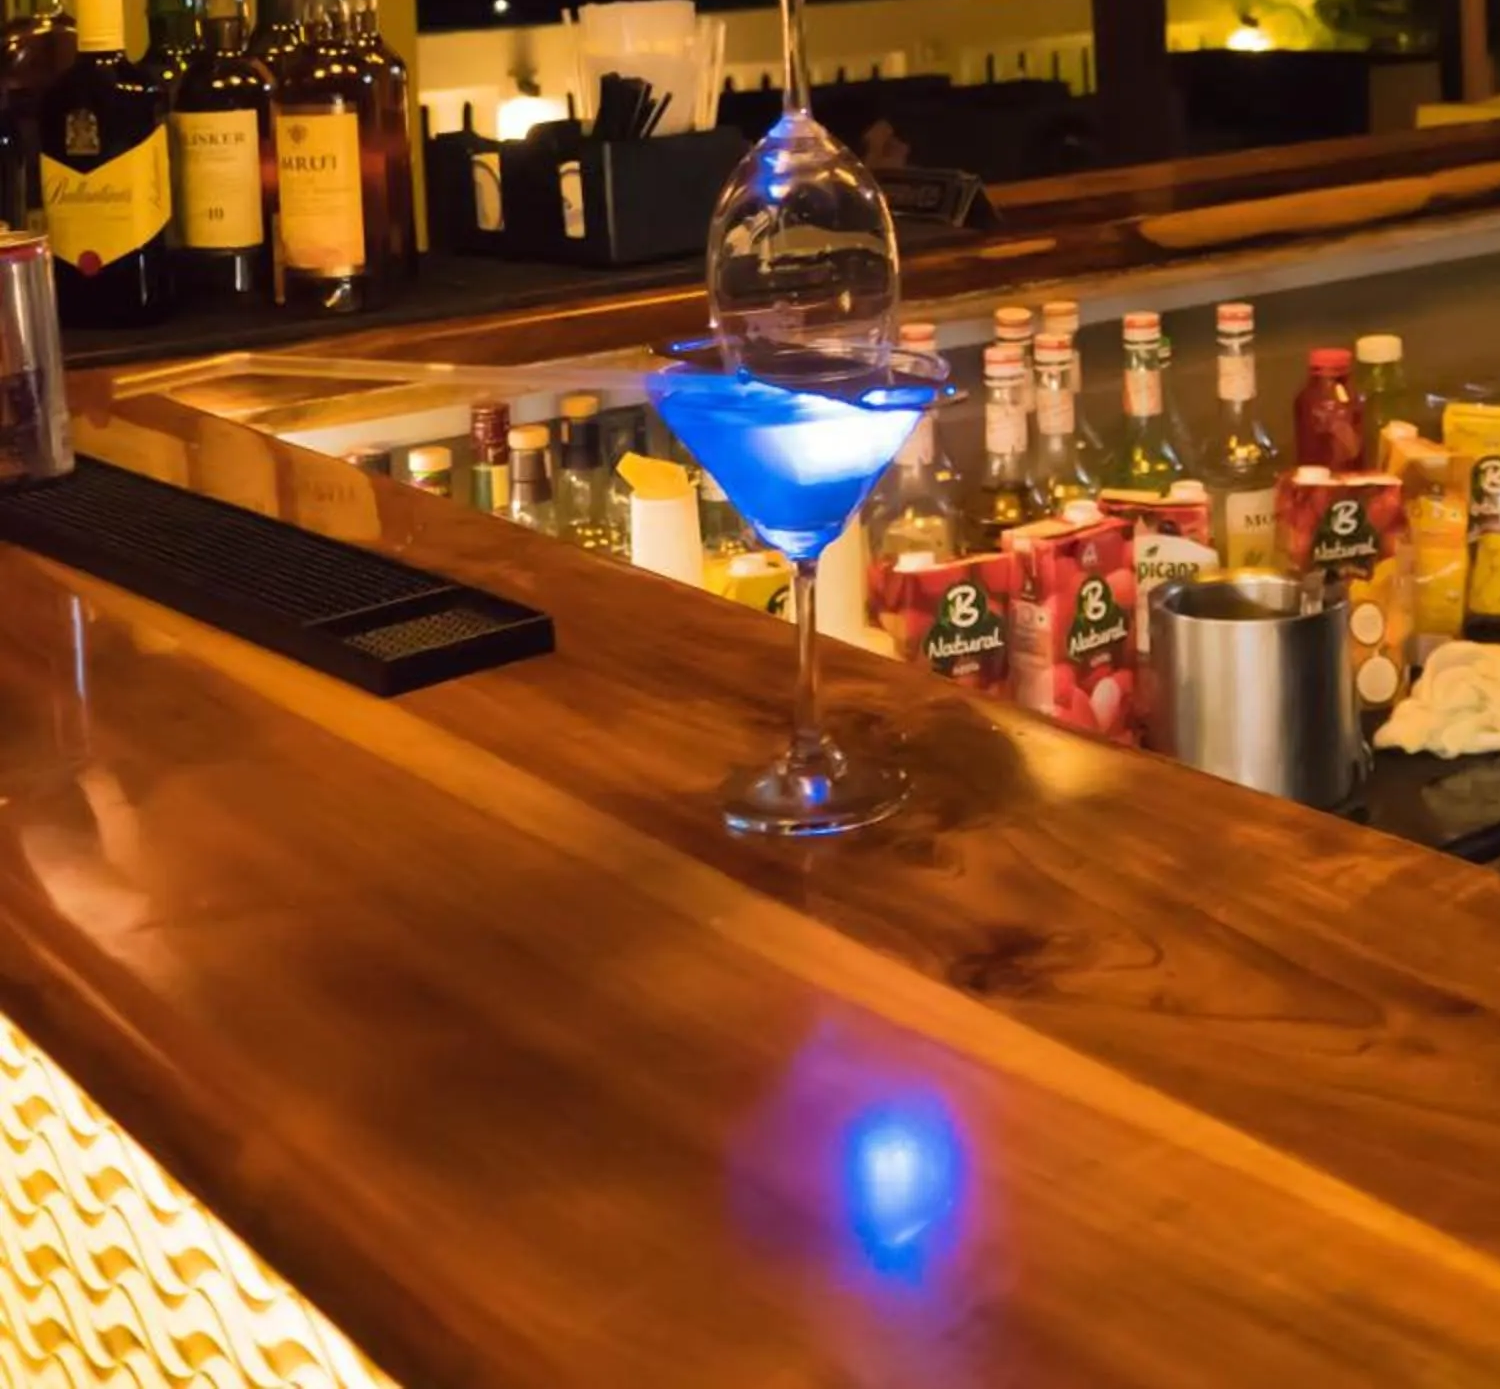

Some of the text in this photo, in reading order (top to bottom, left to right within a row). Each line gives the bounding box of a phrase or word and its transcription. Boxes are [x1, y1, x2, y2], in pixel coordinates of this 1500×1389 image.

[1332, 500, 1358, 536] B
[1314, 535, 1377, 562] Natural
[946, 584, 980, 628] B
[1081, 580, 1108, 622] B
[928, 626, 1005, 660] Natural
[1069, 617, 1128, 657] Natural
